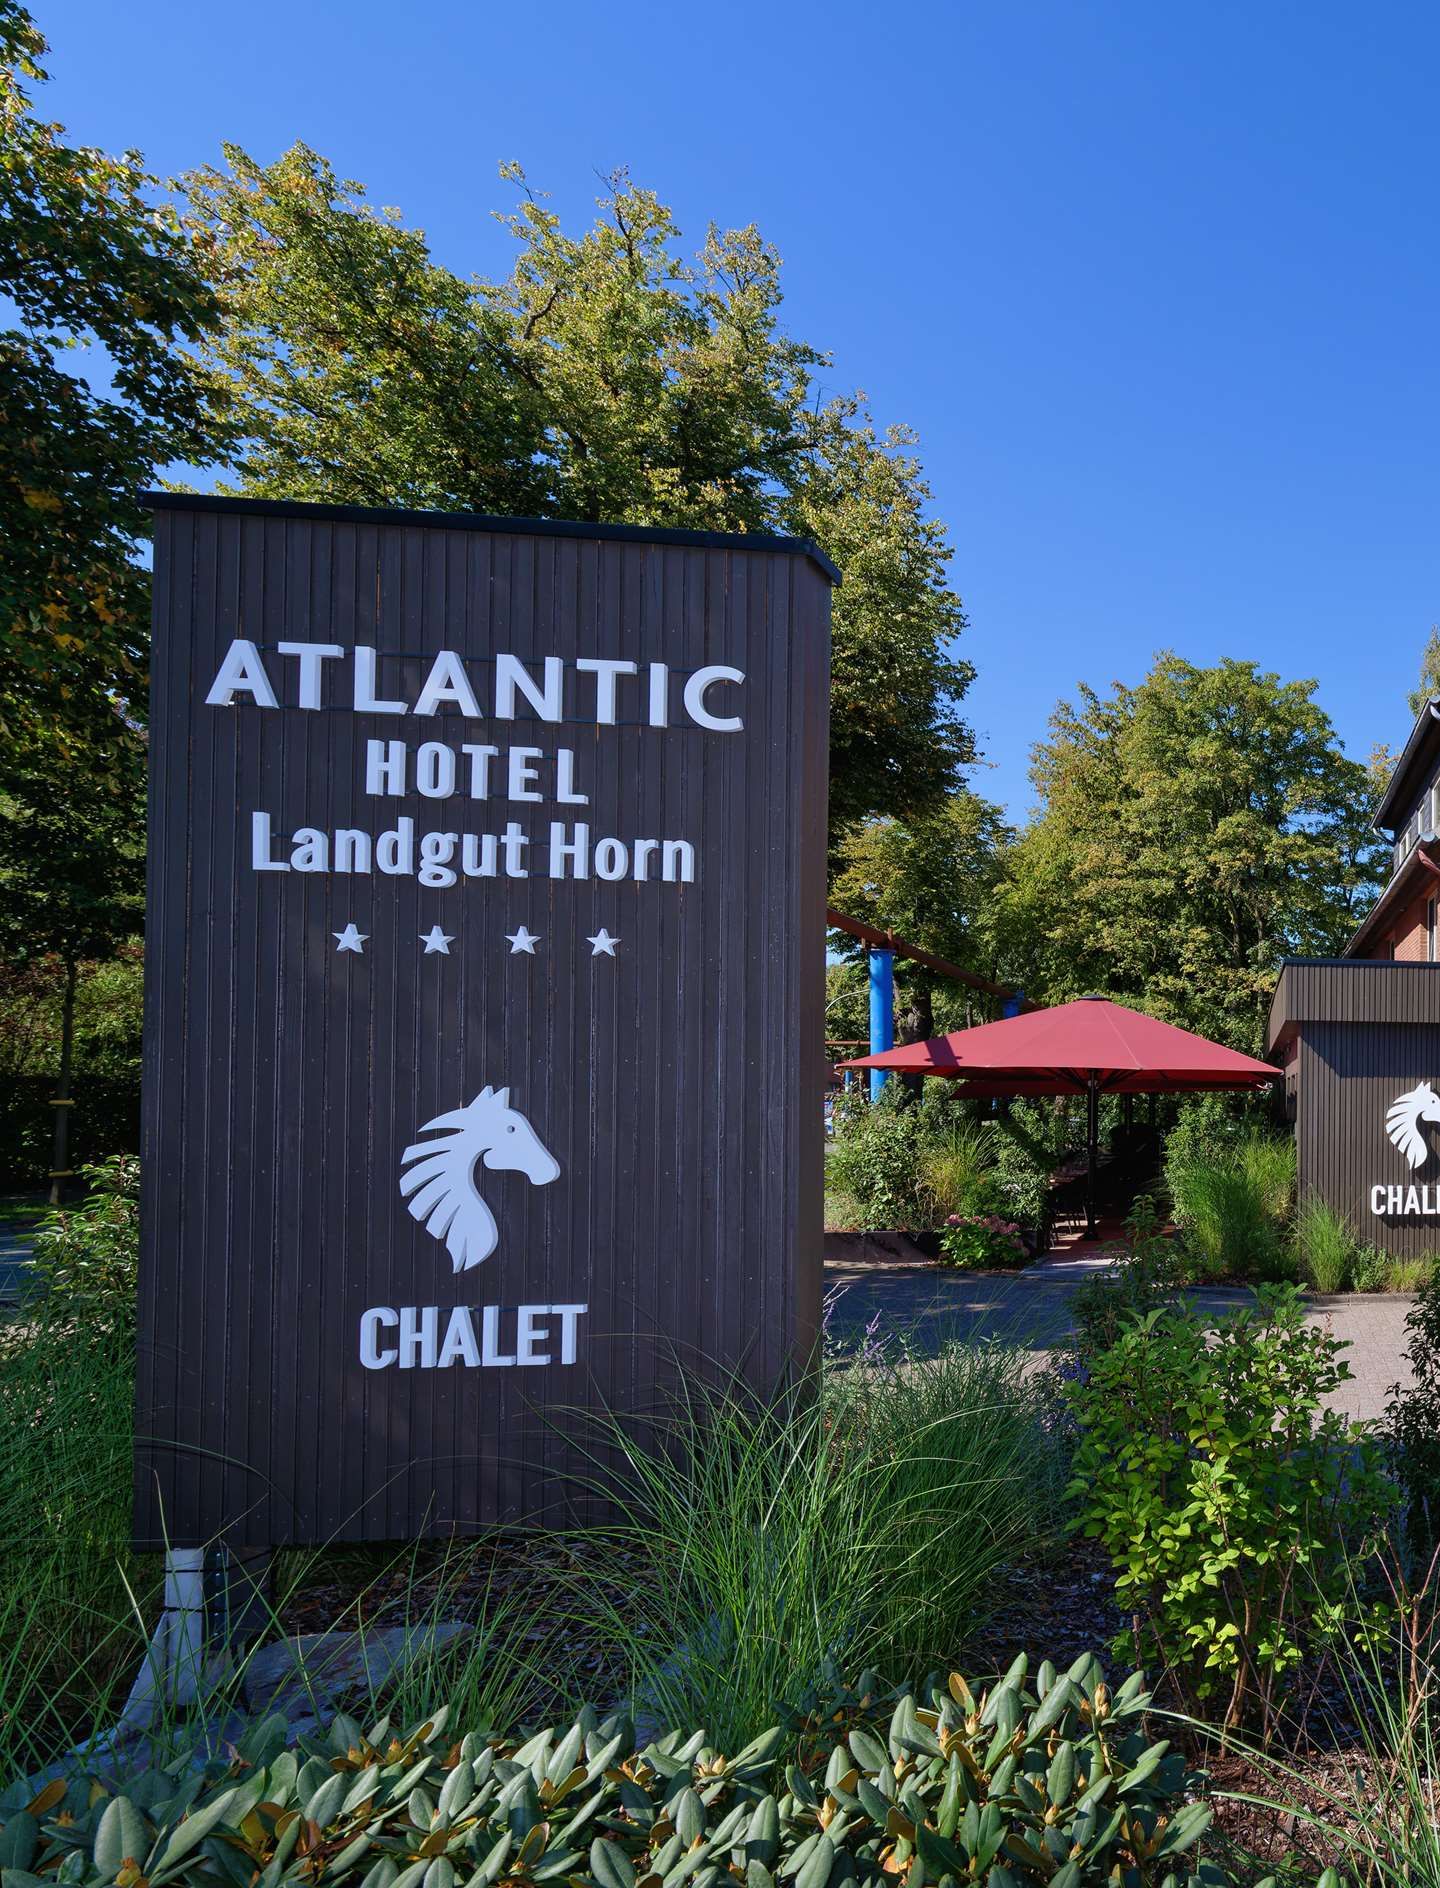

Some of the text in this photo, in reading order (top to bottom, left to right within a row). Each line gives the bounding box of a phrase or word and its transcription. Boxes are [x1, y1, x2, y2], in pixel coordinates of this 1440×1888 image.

[205, 639, 746, 733] ATLANTIC
[366, 739, 590, 805] HOTEL
[252, 811, 695, 888] Landgut Horn
[359, 1303, 589, 1370] CHALET
